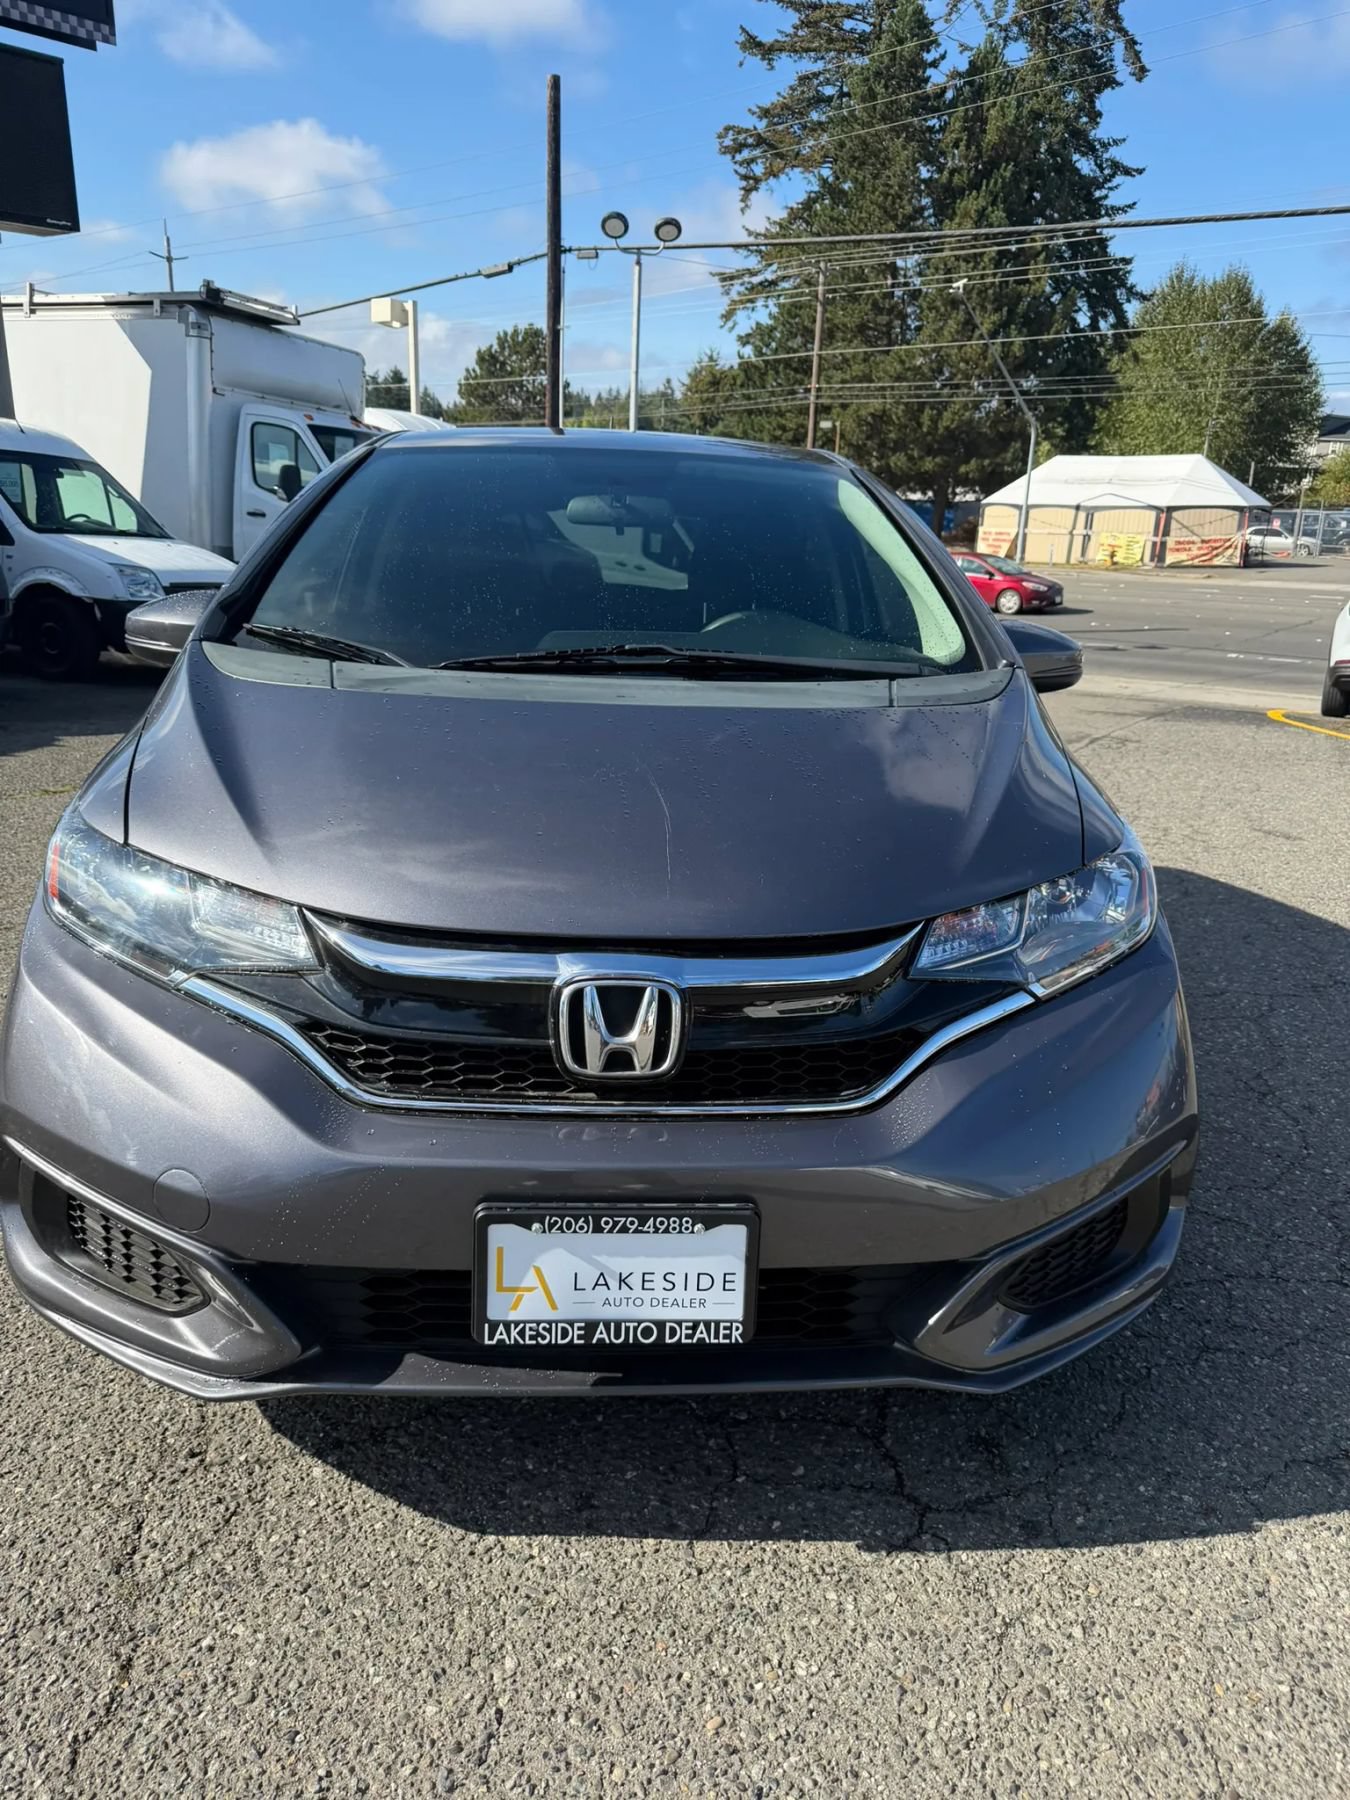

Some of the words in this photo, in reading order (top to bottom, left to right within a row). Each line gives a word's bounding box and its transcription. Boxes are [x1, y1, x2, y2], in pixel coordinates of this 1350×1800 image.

[544, 1216, 594, 1234] (206)
[600, 1217, 693, 1234] 979-4988
[574, 1271, 737, 1292] LAKESIDE
[601, 1297, 645, 1308] AUTO
[650, 1297, 707, 1309] DEALER
[484, 1322, 585, 1345] LAKESIDE
[592, 1322, 658, 1344] AUTO
[664, 1322, 744, 1344] DEALER
